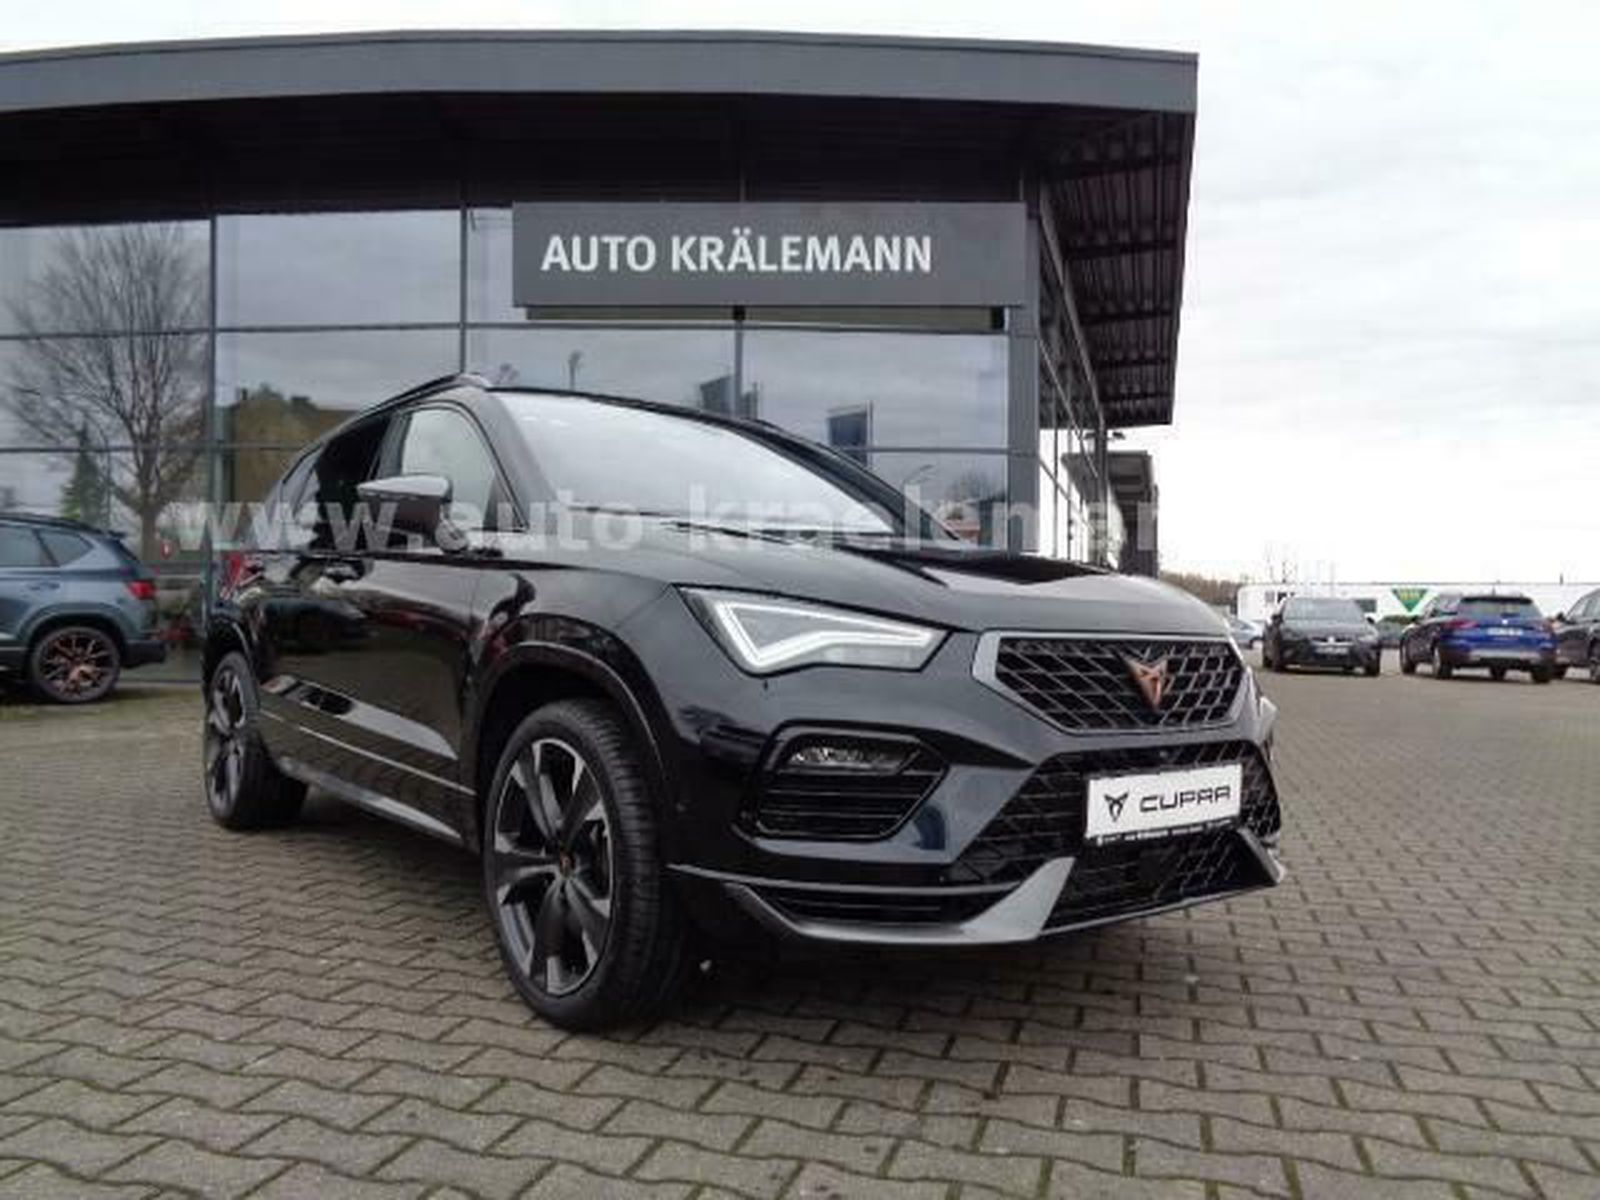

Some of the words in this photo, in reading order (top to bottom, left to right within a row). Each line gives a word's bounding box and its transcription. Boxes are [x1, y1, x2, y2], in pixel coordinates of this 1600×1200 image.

[541, 234, 656, 273] AUTO
[671, 226, 932, 273] KRÄLEMANN
[1139, 785, 1231, 813] CUPRA
